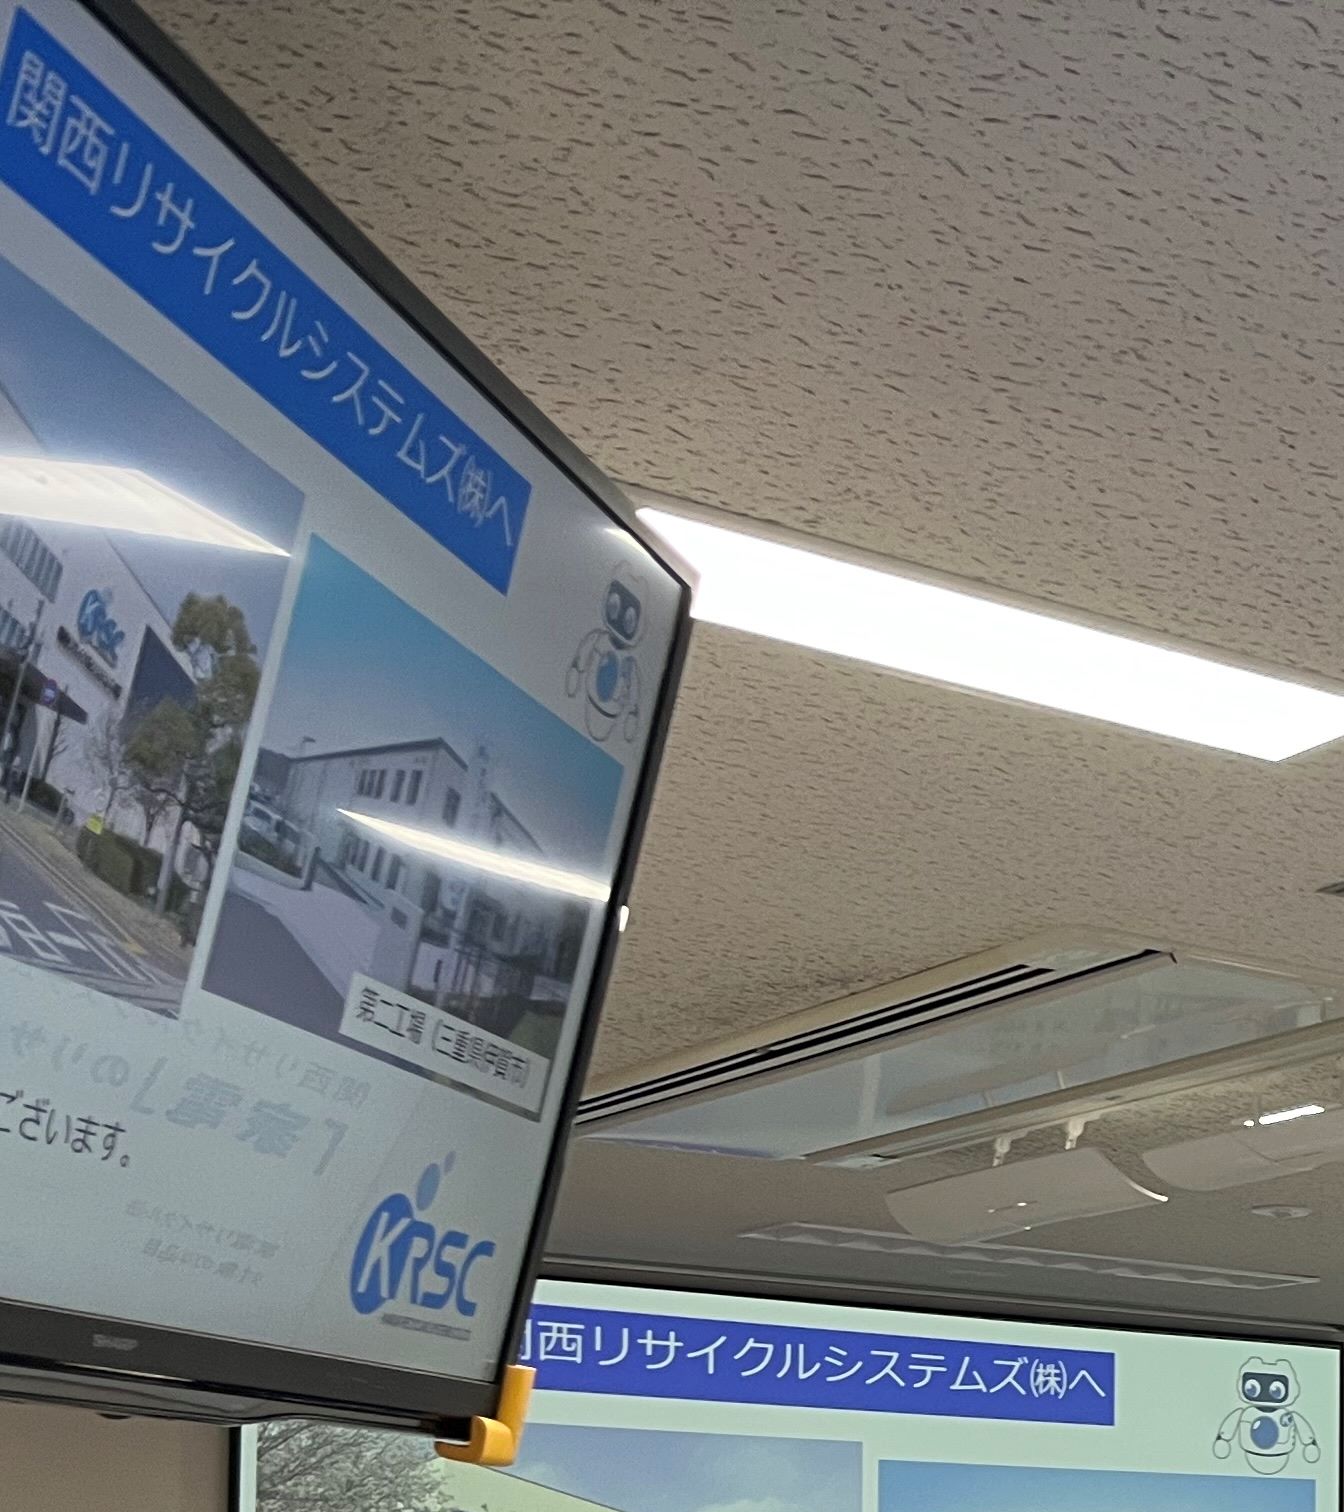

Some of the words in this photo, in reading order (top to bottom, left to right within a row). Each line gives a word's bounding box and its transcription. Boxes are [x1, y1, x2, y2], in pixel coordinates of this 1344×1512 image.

[352, 1195, 496, 1316] KRSC
[519, 1319, 1107, 1400] 西リサイクルシステムズ㈱へ
